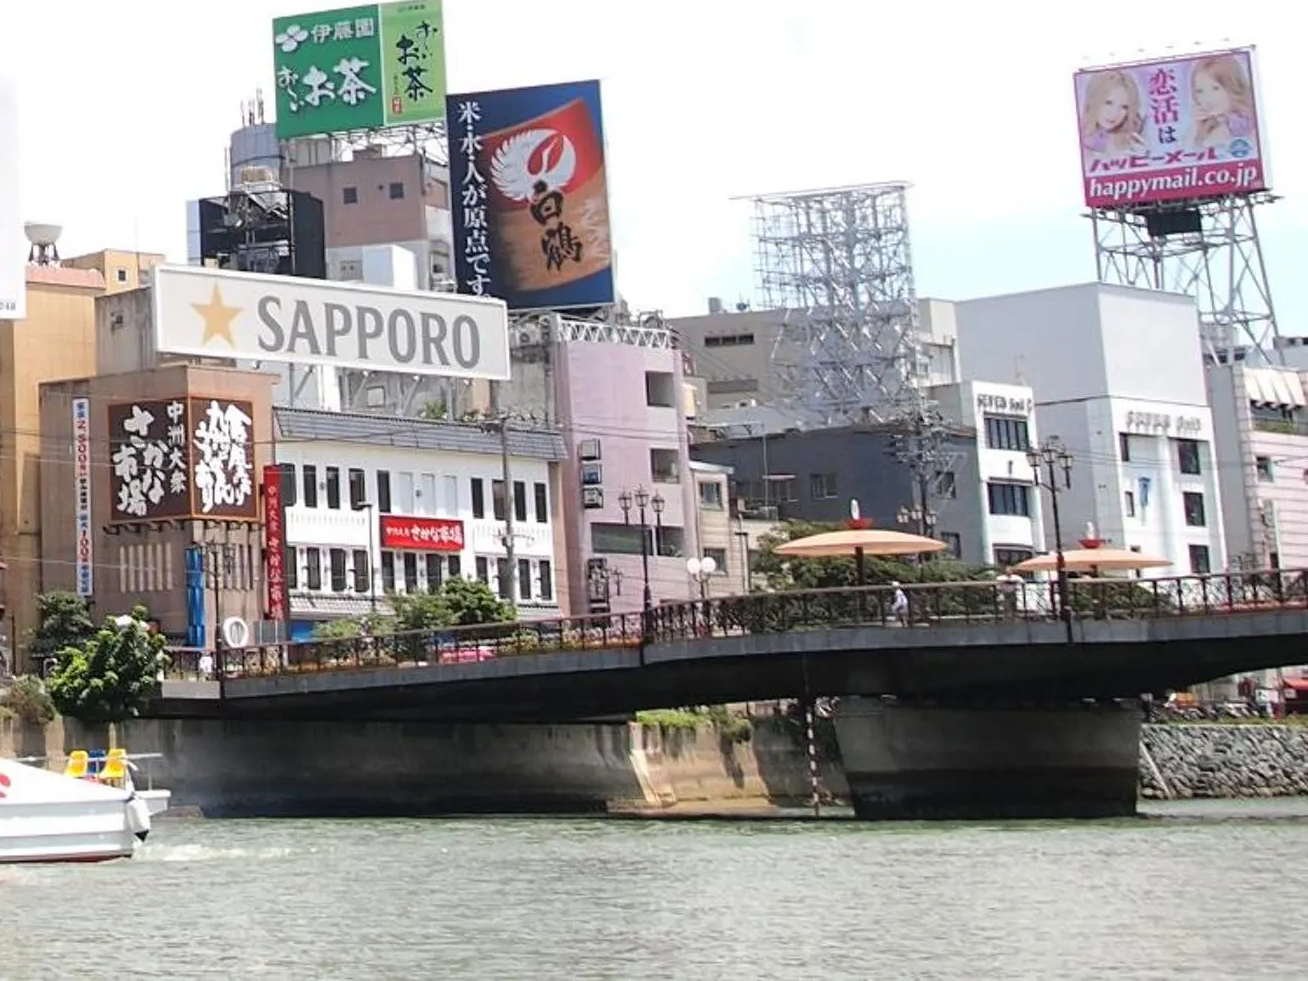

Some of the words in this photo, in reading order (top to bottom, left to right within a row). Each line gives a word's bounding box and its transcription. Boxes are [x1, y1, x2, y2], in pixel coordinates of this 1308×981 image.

[311, 17, 374, 43] 伊藤園
[1090, 147, 1218, 172] ハッピーメール
[1090, 163, 1257, 199] happymail.co.jp
[529, 180, 583, 272] 白鶴
[256, 295, 481, 370] SAPPORO
[166, 400, 186, 494] 中洲大衆
